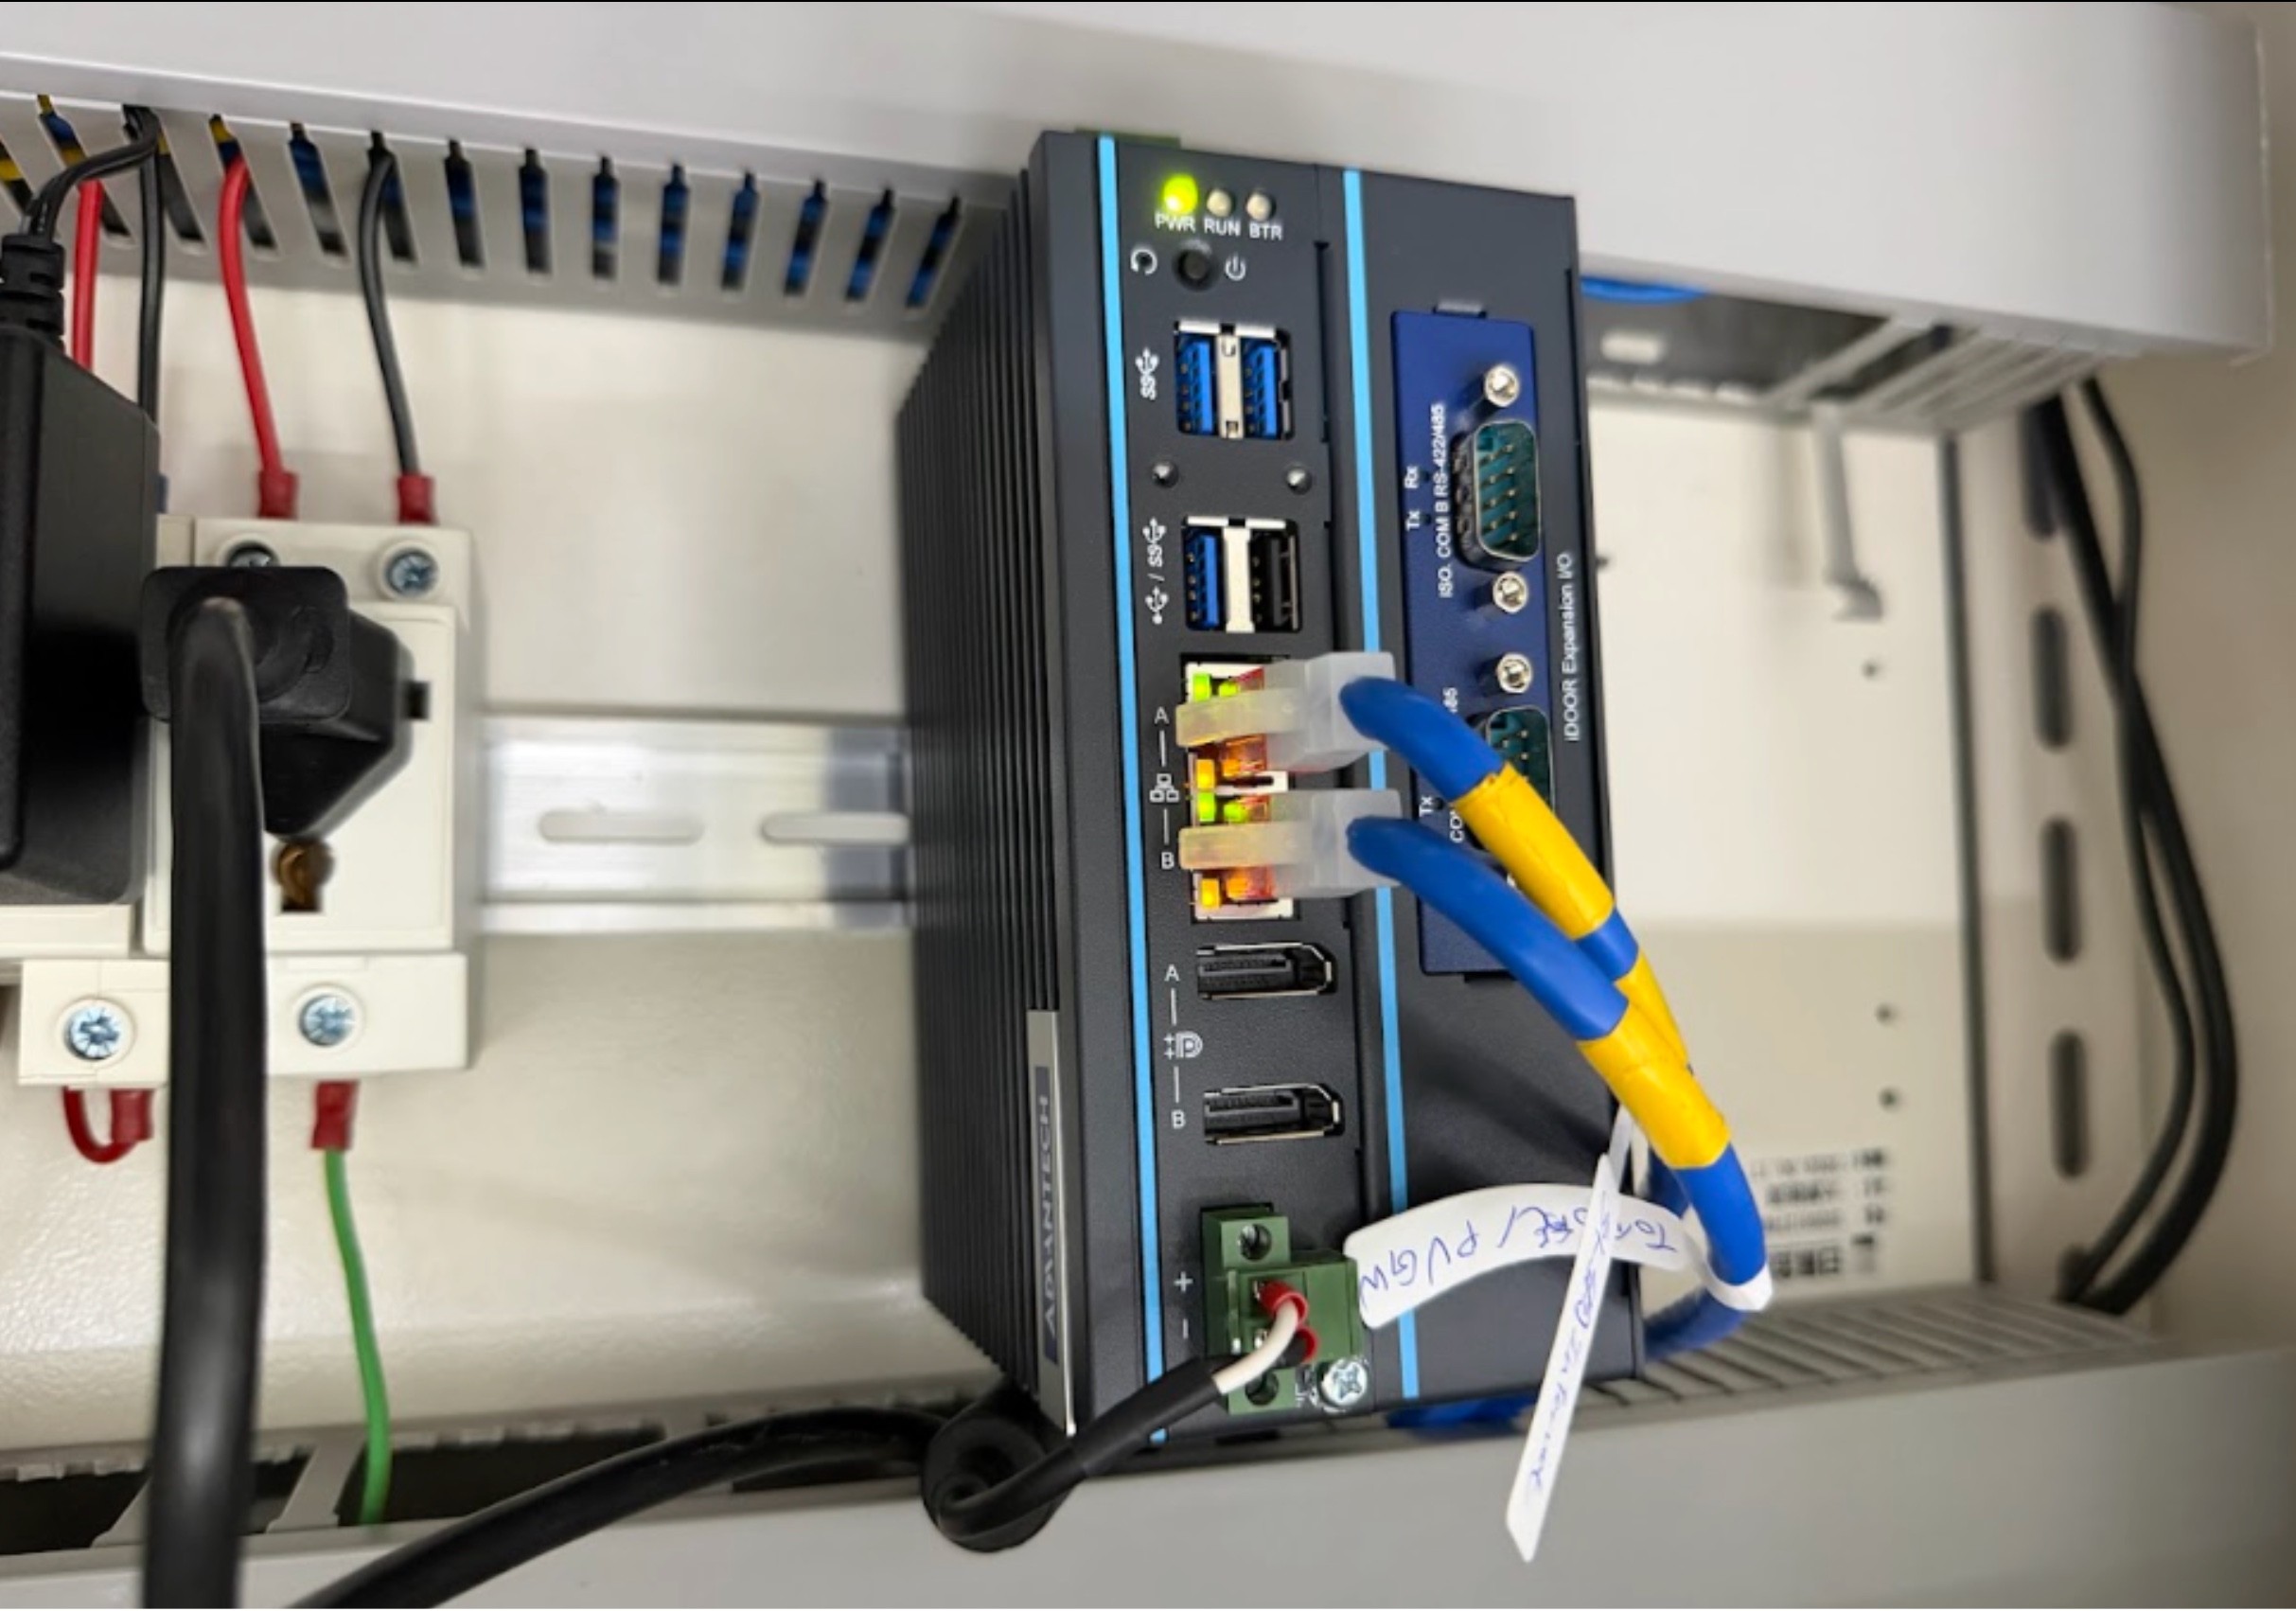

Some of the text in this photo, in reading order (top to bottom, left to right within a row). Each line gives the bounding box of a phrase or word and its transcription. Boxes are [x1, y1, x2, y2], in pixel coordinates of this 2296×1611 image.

[1155, 212, 1282, 240] PWR RUN BTR
[1404, 466, 1421, 531] Tx Rx
[1430, 403, 1454, 598] ISO. COM B RS-422/485
[1556, 553, 1573, 579] I/O
[1559, 584, 1580, 675] Expansion
[1154, 706, 1170, 725] A
[1419, 796, 1434, 818] Tx
[1160, 852, 1175, 870] B
[1164, 964, 1180, 983] A
[1171, 1109, 1187, 1130] B
[1039, 1095, 1056, 1337] ADVANTECH
